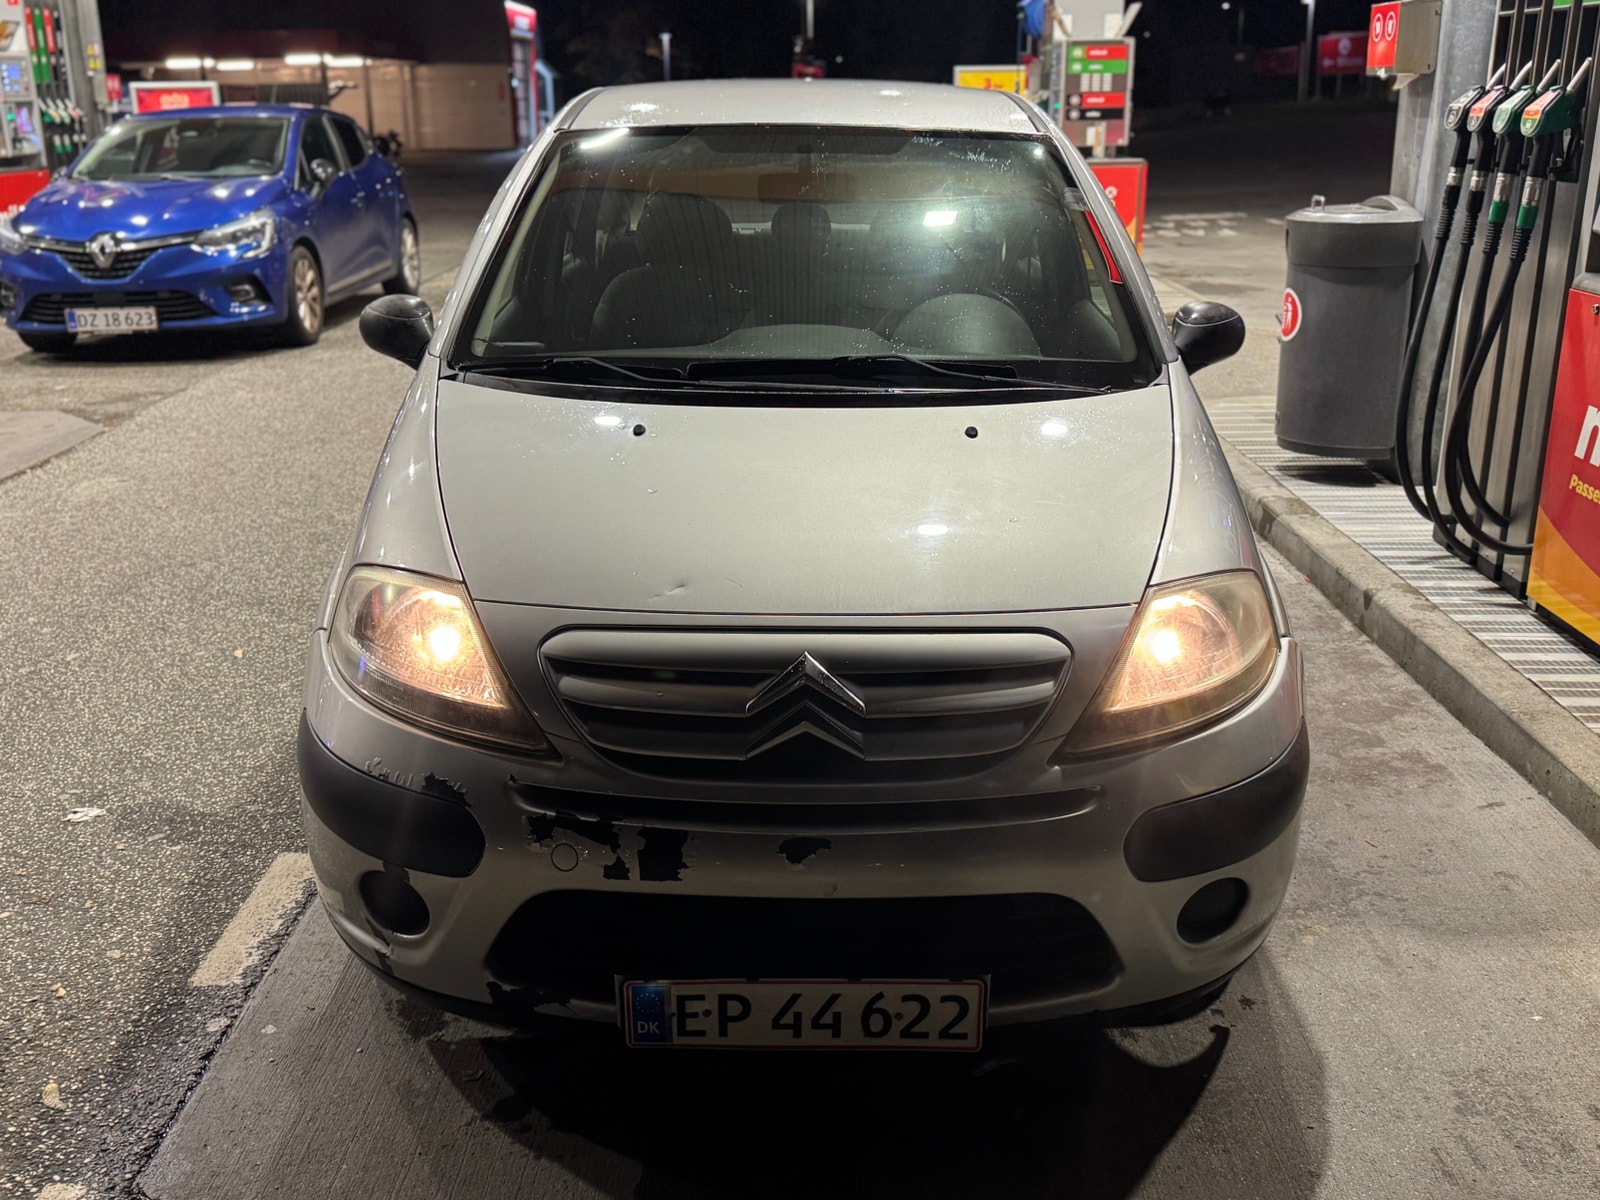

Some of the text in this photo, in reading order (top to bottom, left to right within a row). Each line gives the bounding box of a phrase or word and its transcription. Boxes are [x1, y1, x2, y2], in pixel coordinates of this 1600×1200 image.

[77, 311, 154, 327] DZ 18 623
[1569, 473, 1600, 505] Passe
[637, 1021, 660, 1034] DK
[675, 991, 970, 1040] EP 44 622
